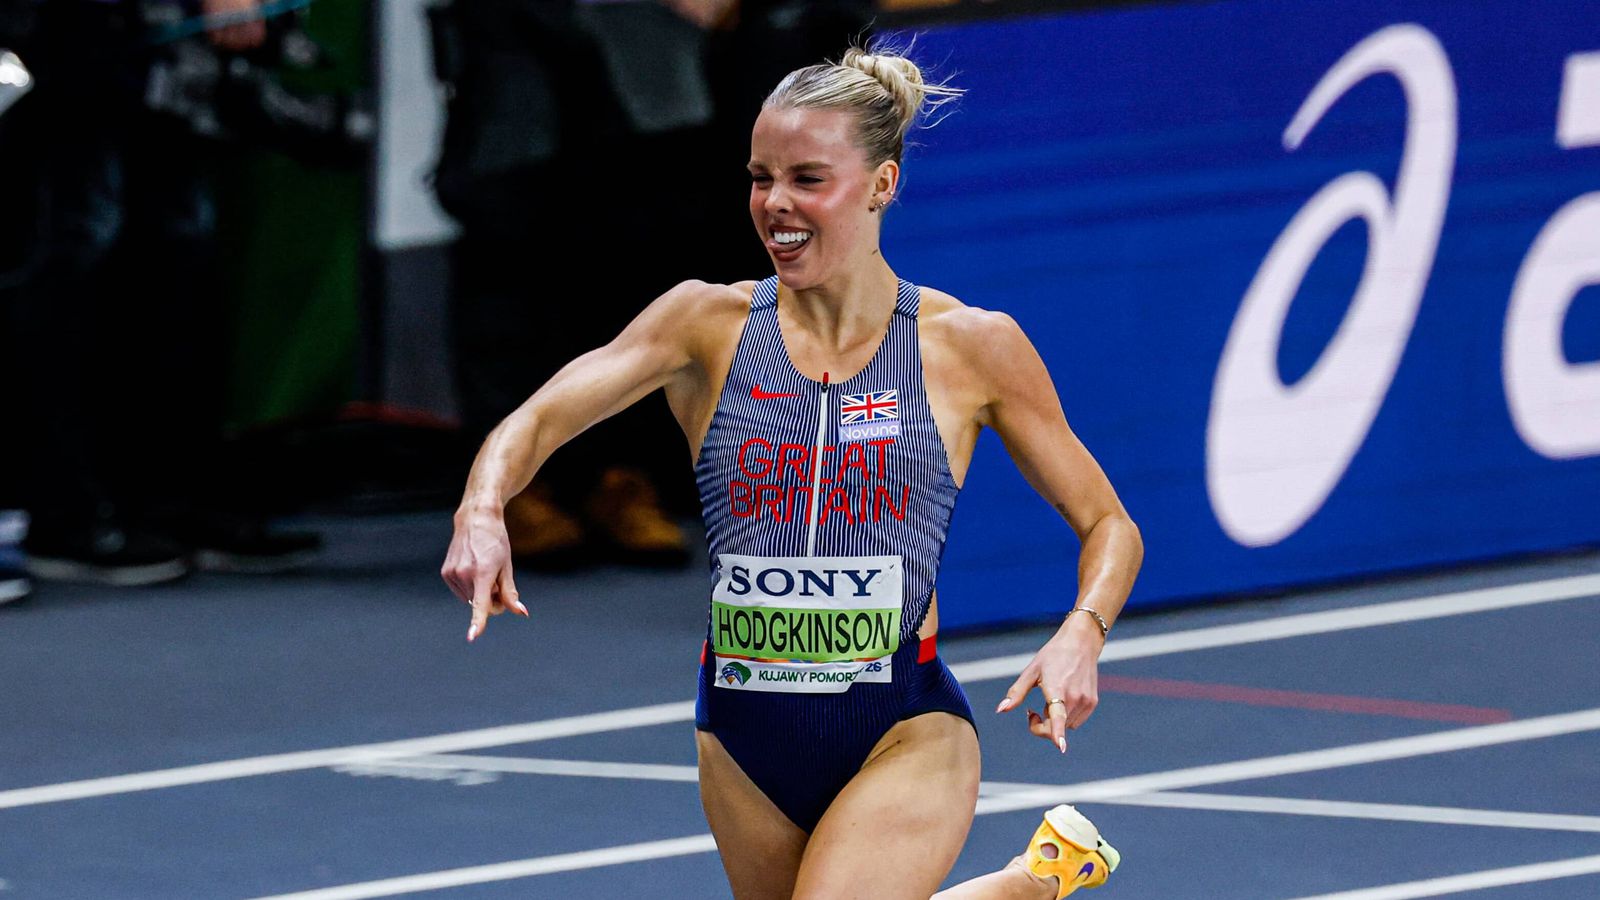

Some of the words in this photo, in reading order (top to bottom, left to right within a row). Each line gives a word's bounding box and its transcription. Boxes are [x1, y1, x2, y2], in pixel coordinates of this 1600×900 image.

[840, 424, 899, 440] Novuna
[738, 437, 895, 483] GREAT
[729, 480, 910, 526] BRITAIN
[727, 565, 882, 597] SONY
[718, 607, 893, 654] HODGKINSON
[758, 670, 806, 683] KUJAWY
[864, 662, 882, 673] 26
